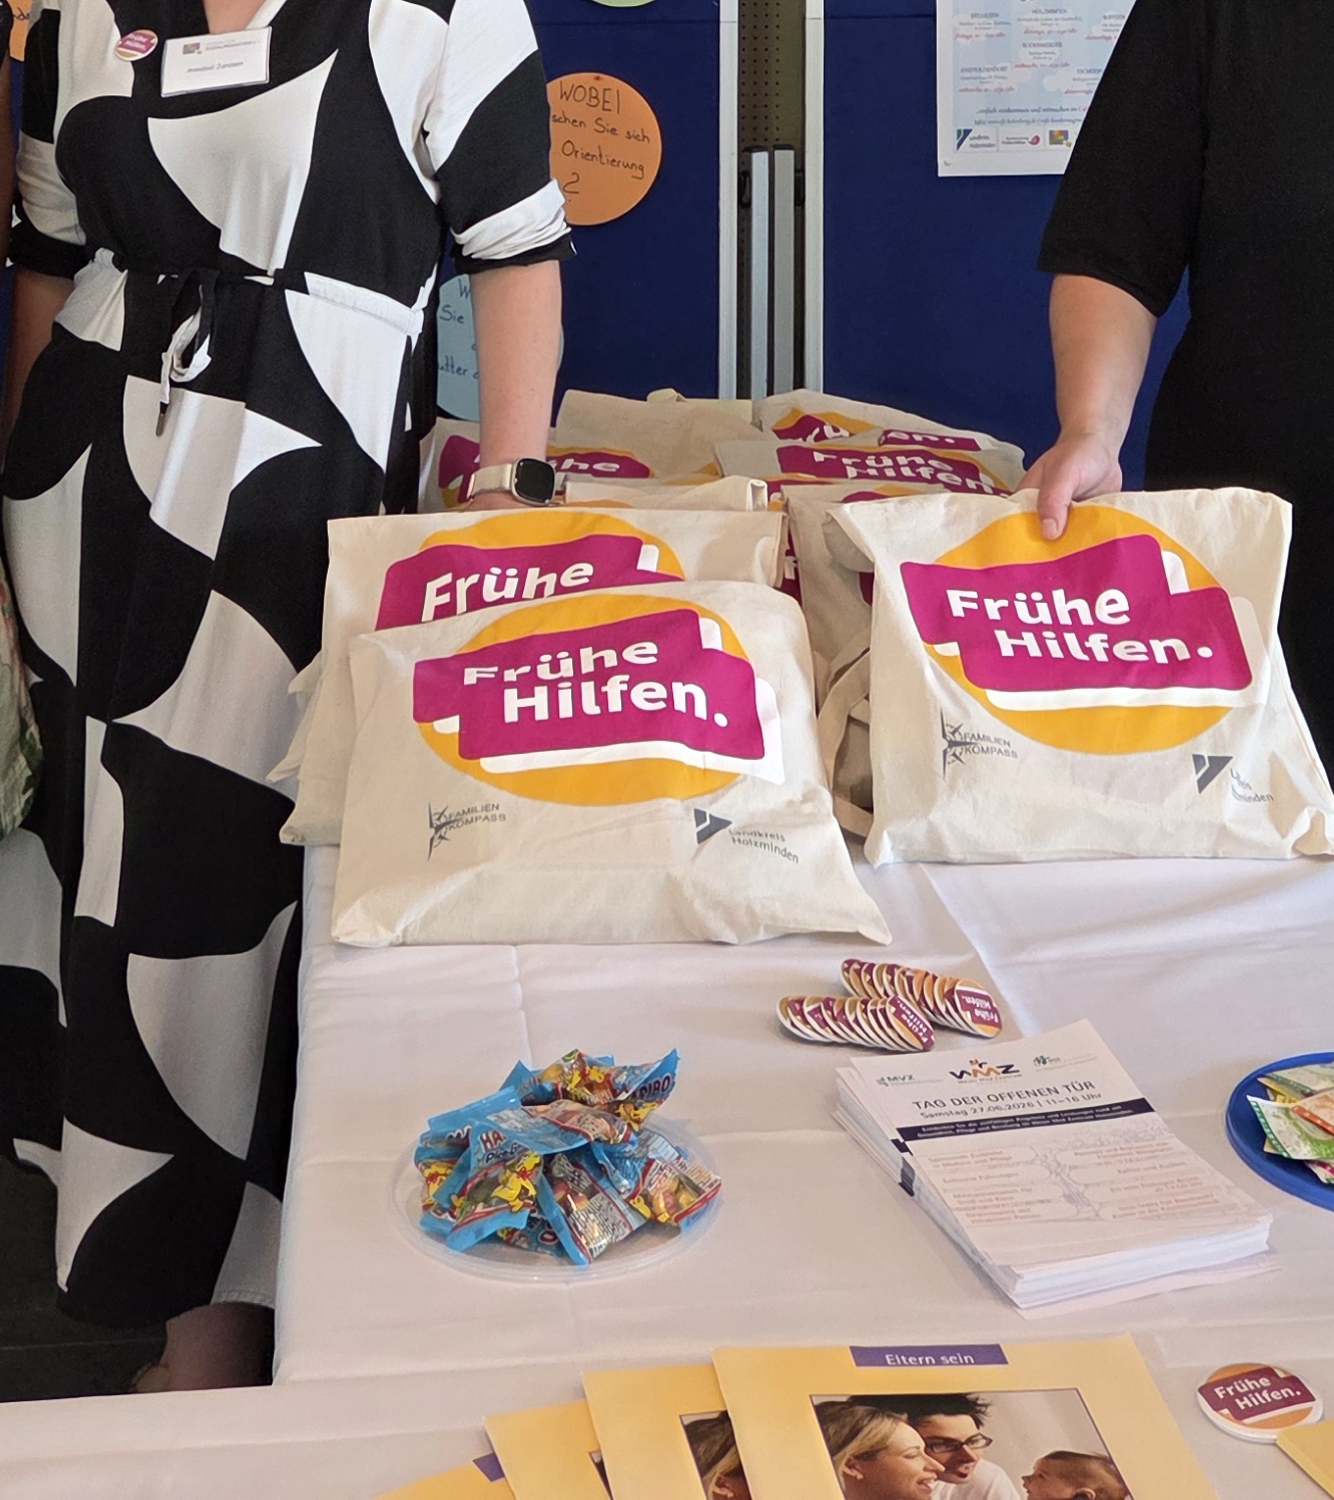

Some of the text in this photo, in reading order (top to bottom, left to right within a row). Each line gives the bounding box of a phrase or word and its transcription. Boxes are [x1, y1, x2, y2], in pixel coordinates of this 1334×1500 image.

[559, 81, 621, 115] WOBEI
[594, 117, 650, 143] Sie sich
[561, 140, 645, 180] Orientierung
[439, 304, 465, 324] Sie
[422, 562, 594, 622] Frühe
[945, 588, 1130, 626] Frühe
[994, 630, 1213, 664] Hilfen.
[464, 639, 658, 685] Frühe
[504, 675, 728, 727] Hilfen.
[962, 744, 1018, 759] KOMPASS
[963, 732, 1011, 747] FAMILIEN
[448, 813, 506, 831] KOMPASS
[449, 803, 500, 821] FAMILIEN
[731, 836, 800, 864] Holzminden
[887, 1074, 915, 1082] MVZ
[913, 1080, 1096, 1111] TAG DER OFFENEN TÜR
[920, 1108, 968, 1120] Samstag
[973, 1101, 1035, 1115] 27.06.2026
[1082, 1093, 1102, 1102] Uhr
[885, 1353, 975, 1366] Eltern sein
[1214, 1377, 1271, 1399] Frühe
[1235, 1387, 1301, 1410] Hilfen.
